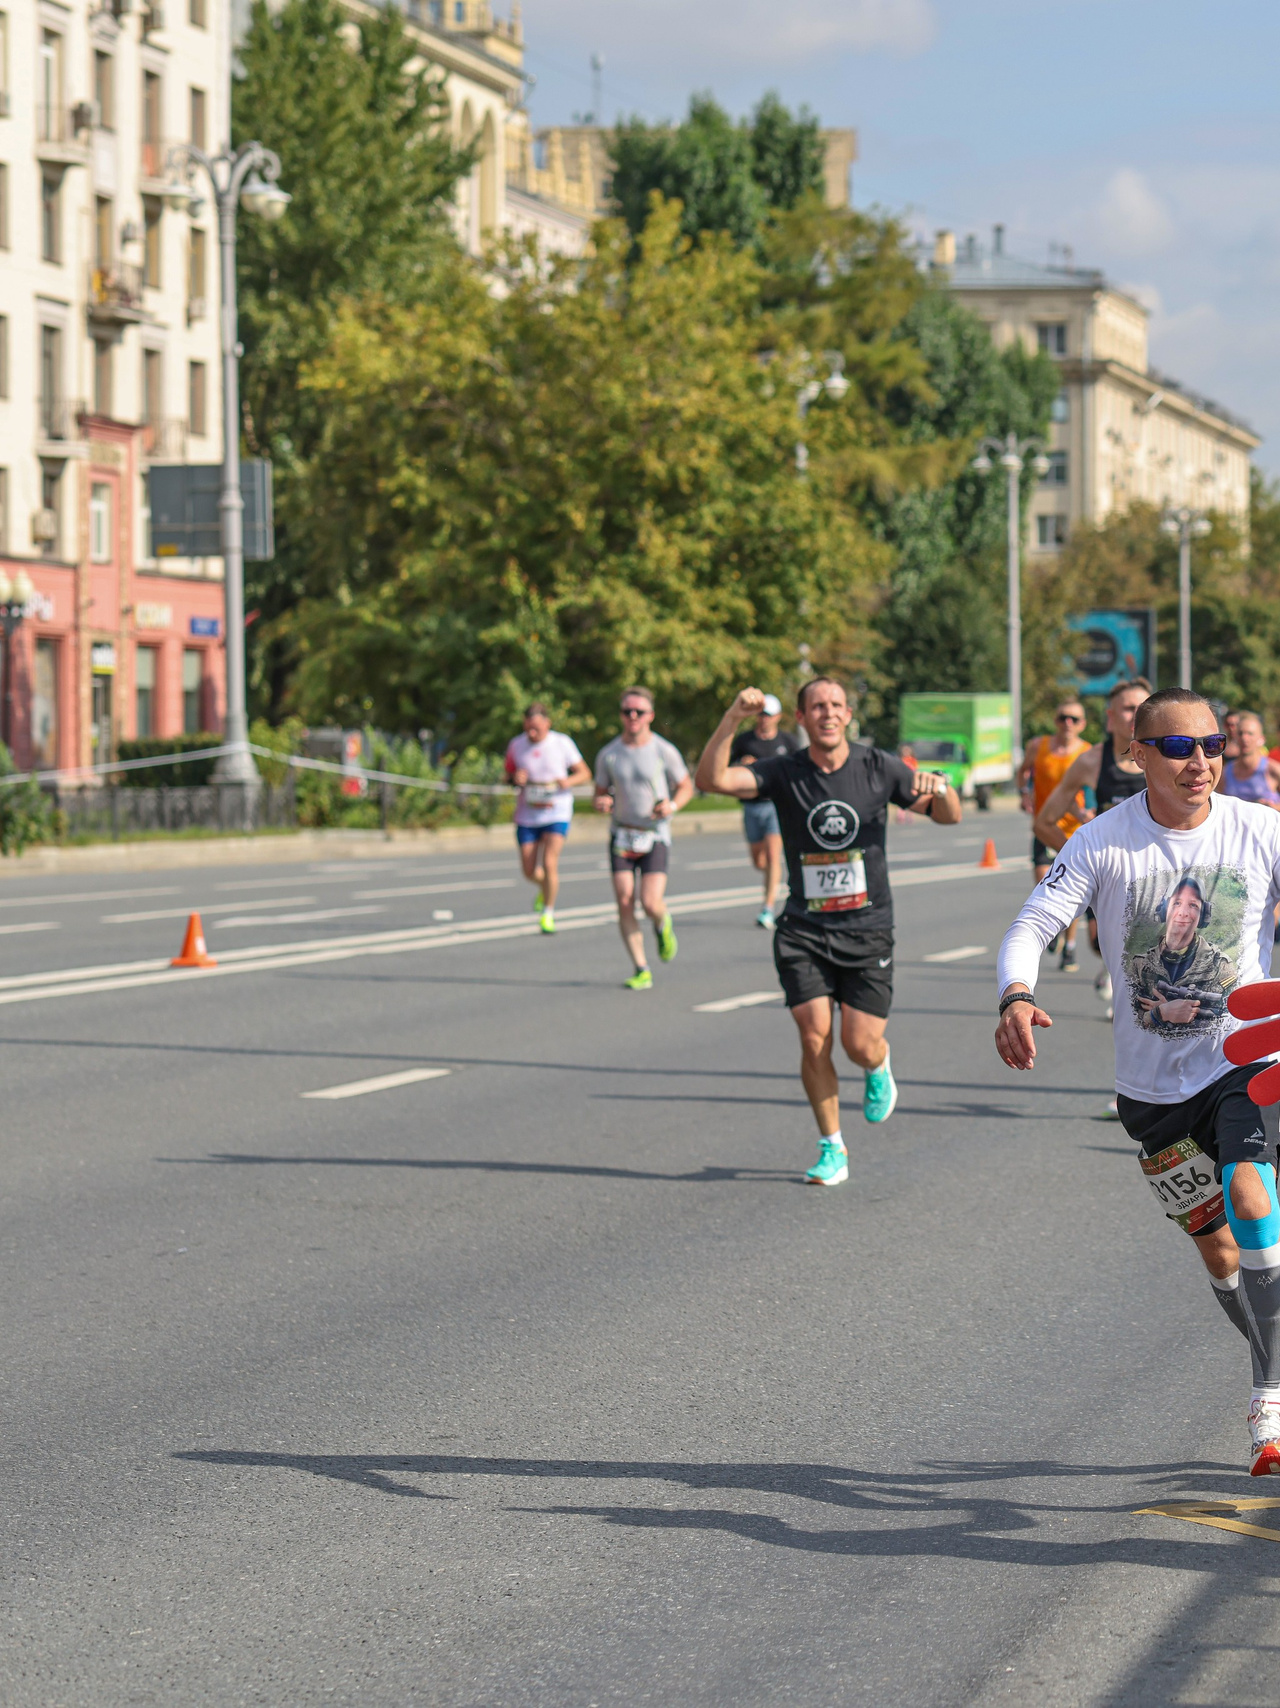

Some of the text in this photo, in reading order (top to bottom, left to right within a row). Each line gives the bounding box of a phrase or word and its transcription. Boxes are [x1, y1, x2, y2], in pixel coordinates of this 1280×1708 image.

[816, 868, 850, 888] 792
[1177, 1140, 1194, 1152] 21,1
[1243, 1137, 1269, 1147] DEMIX
[1150, 1166, 1212, 1203] 3156
[1175, 1190, 1208, 1211] ЭДУАРД
